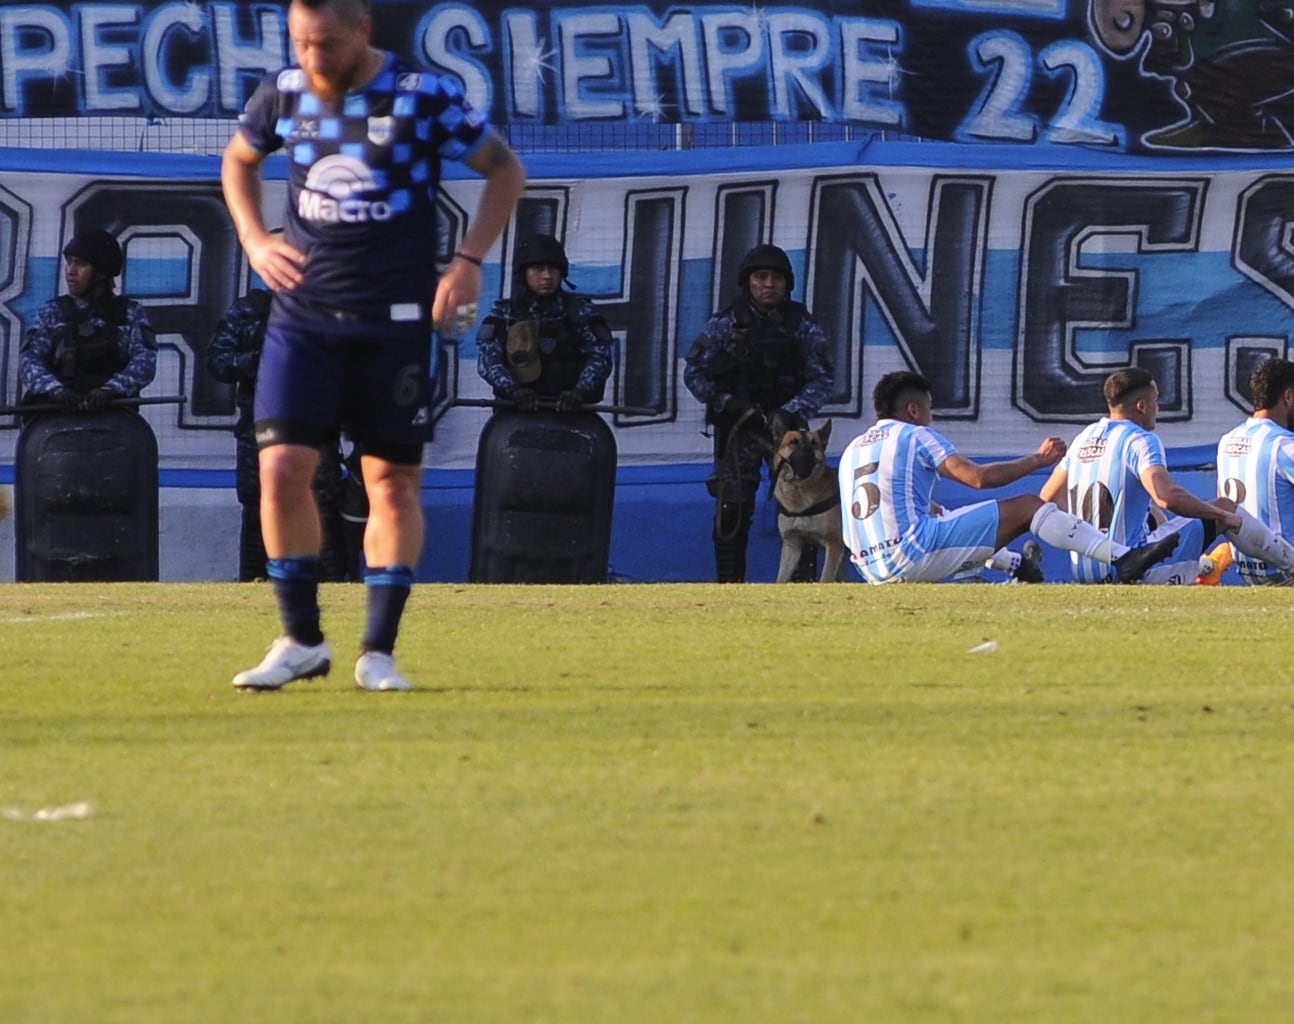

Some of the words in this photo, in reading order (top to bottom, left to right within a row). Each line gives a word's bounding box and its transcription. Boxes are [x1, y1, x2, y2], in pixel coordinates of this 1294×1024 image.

[415, 3, 905, 125] SIEMPRE
[954, 29, 1127, 147] 22
[298, 189, 392, 221] Macro
[851, 462, 881, 520] 5
[1069, 480, 1115, 532] 10
